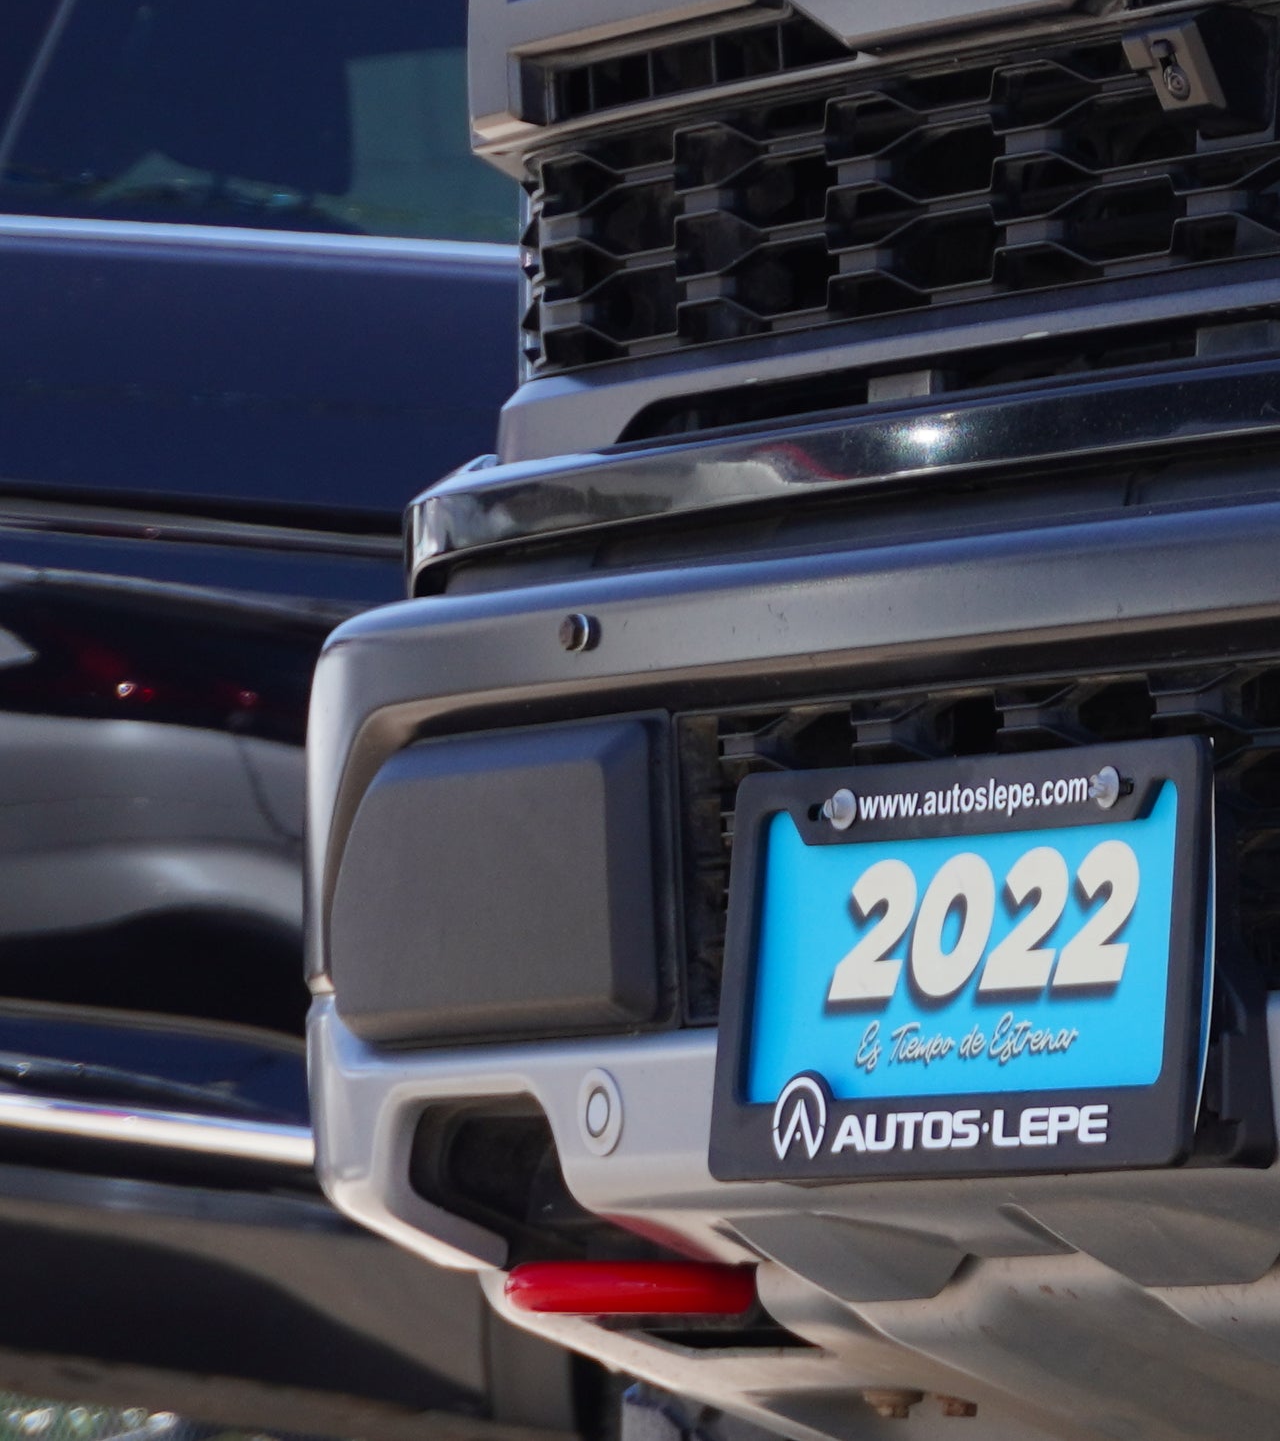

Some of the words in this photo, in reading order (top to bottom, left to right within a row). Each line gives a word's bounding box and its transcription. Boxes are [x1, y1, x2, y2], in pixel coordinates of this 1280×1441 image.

[858, 777, 1088, 820] www.autoslepe.com
[826, 839, 1140, 1005] 2022
[857, 1019, 882, 1072] Es
[888, 1021, 956, 1066] Tiempo
[958, 1023, 986, 1058] de
[988, 1011, 1079, 1065] Estrenar
